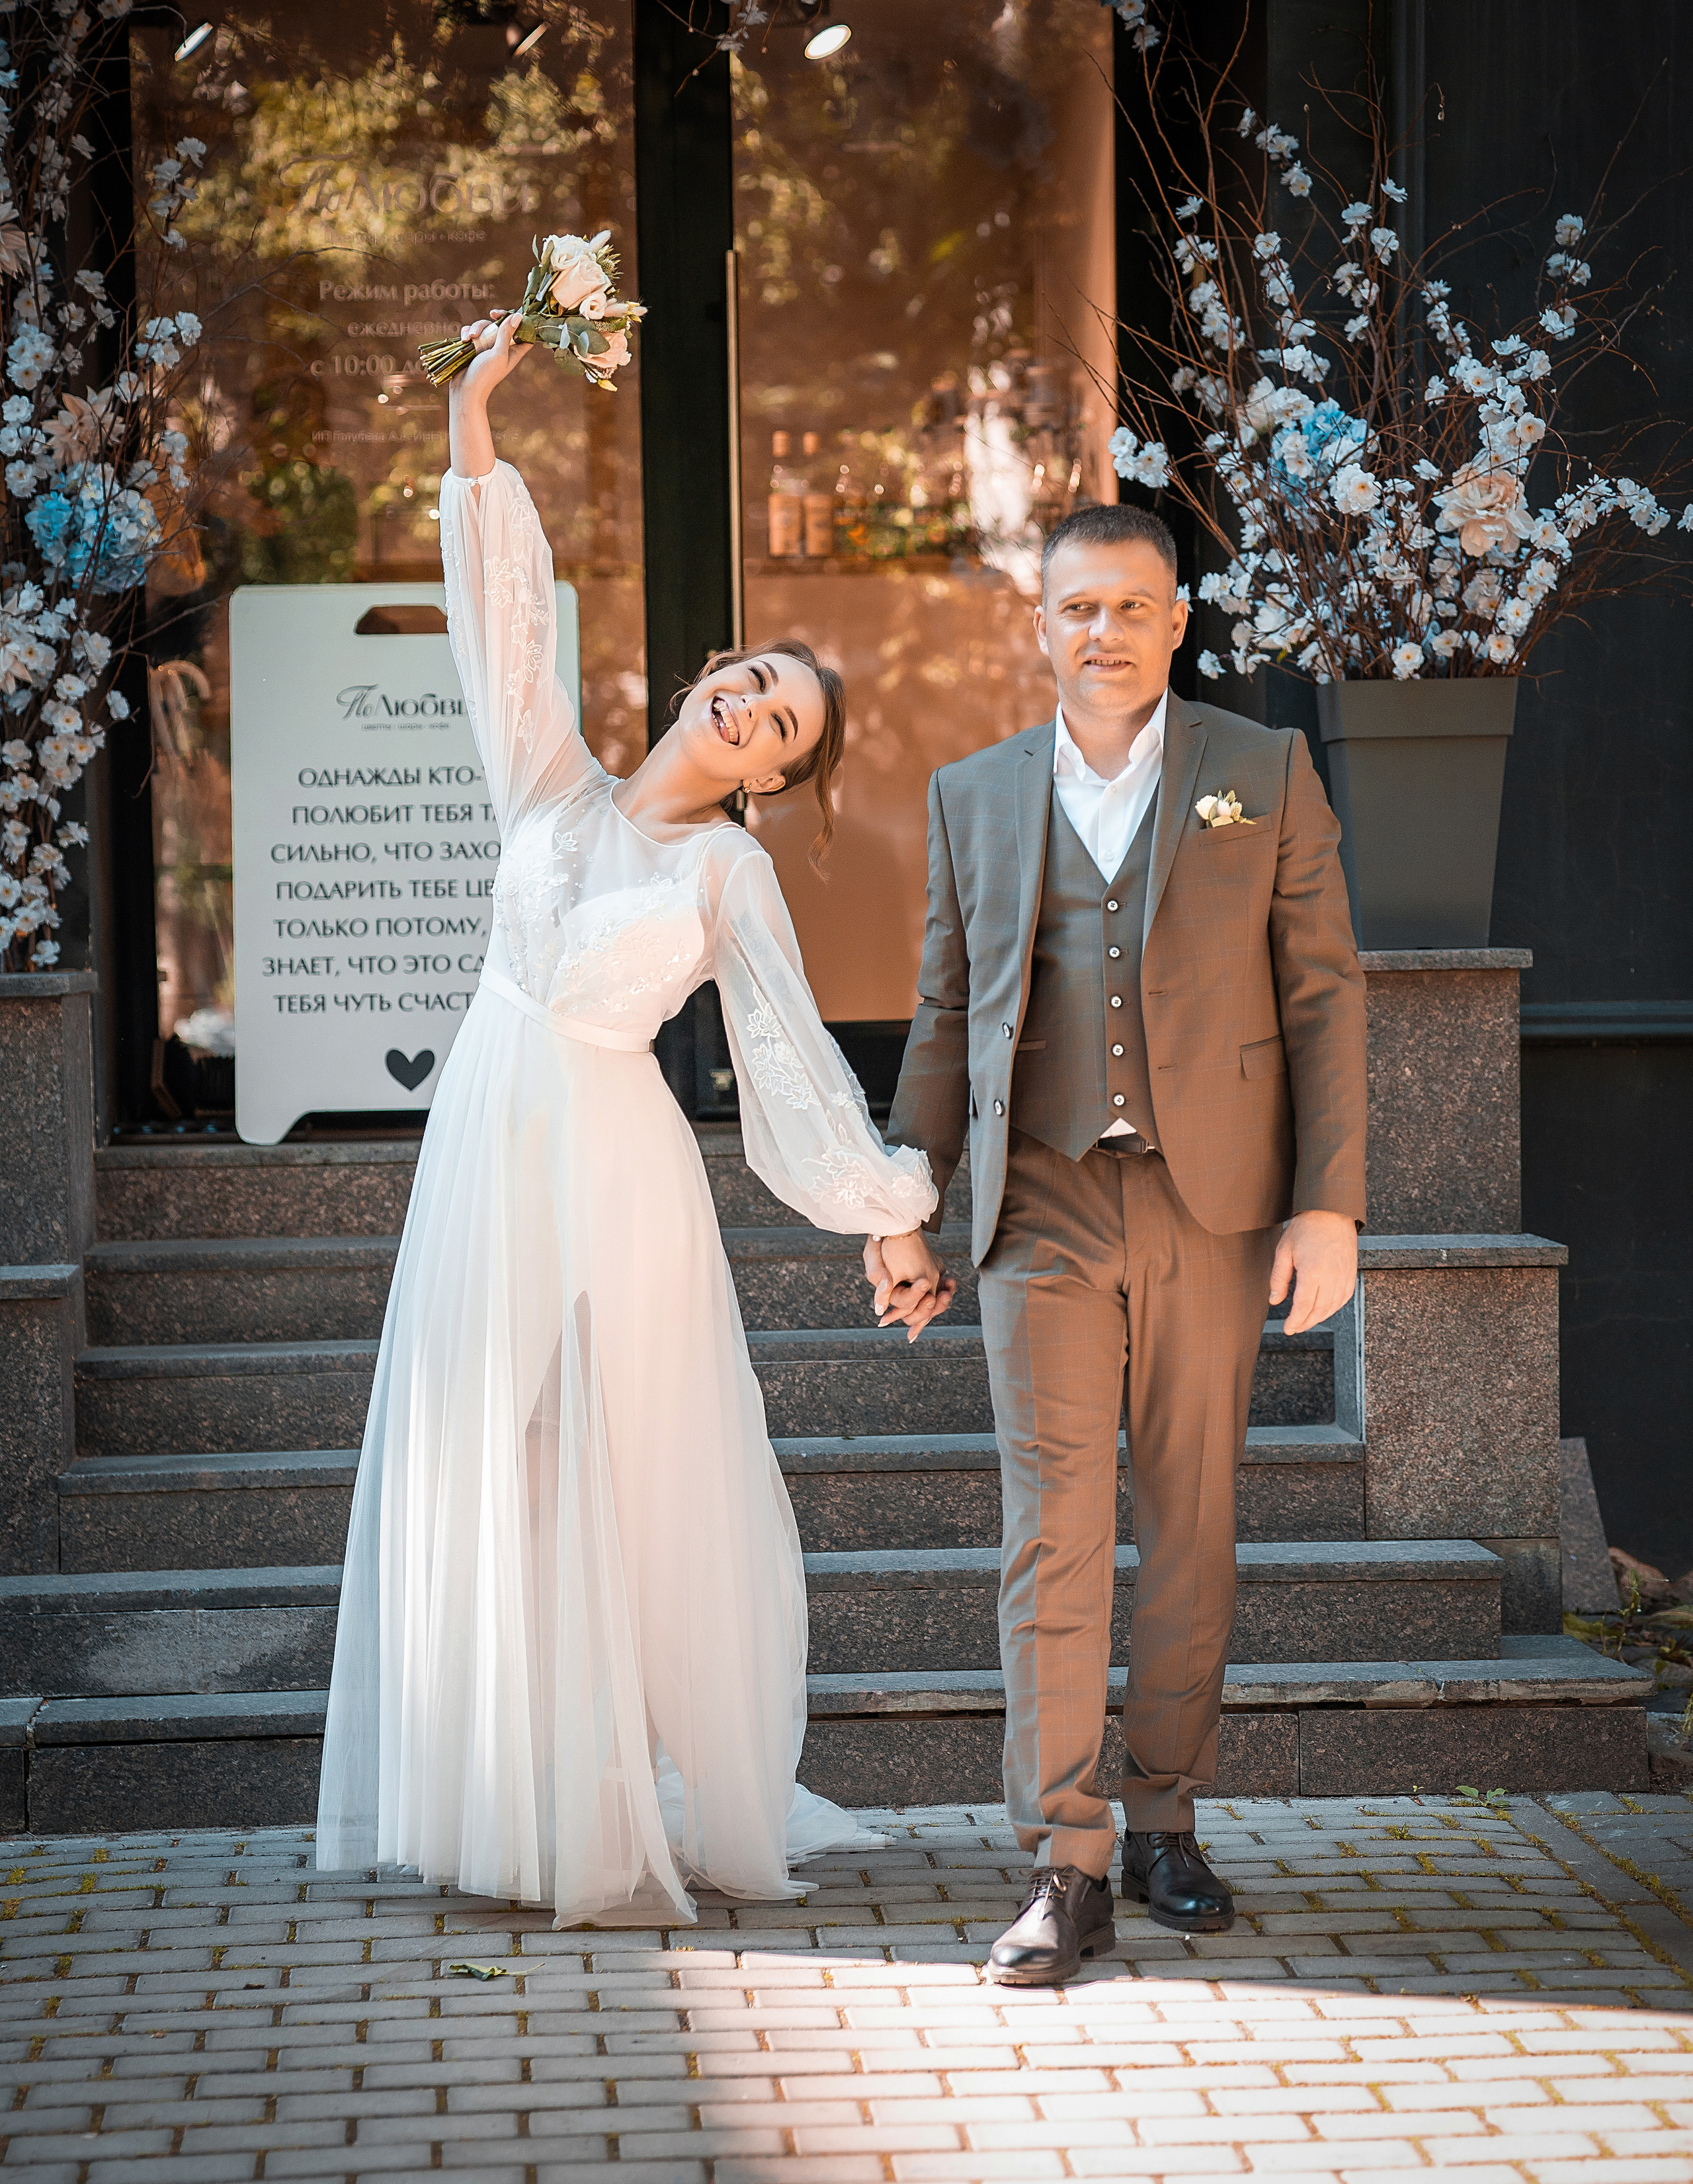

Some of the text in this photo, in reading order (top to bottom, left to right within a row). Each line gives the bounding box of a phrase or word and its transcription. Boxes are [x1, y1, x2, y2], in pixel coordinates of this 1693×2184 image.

[447, 229, 487, 244] кофе
[319, 278, 495, 305] Режим работы:
[347, 321, 462, 339] ежедневно
[333, 354, 395, 376] 10:00
[298, 767, 422, 789] ОДНАЖДЫ
[292, 803, 497, 827] ПОЛЮБИТ ТЕБЯ Т
[270, 840, 501, 866] СИЛЬНО, ЧТО ЗАХО
[276, 880, 403, 902] ПОДАРИТЬ
[409, 879, 458, 900] ТЕБЕ
[273, 916, 487, 940] ТОЛЬКО ПОТОМУ,
[263, 956, 341, 978] ЗНАЕТ,
[348, 955, 398, 976] ЧТО
[403, 954, 453, 975] ЭТО
[273, 994, 327, 1015] ТЕБЯ
[333, 993, 393, 1014] ЧУТЬ
